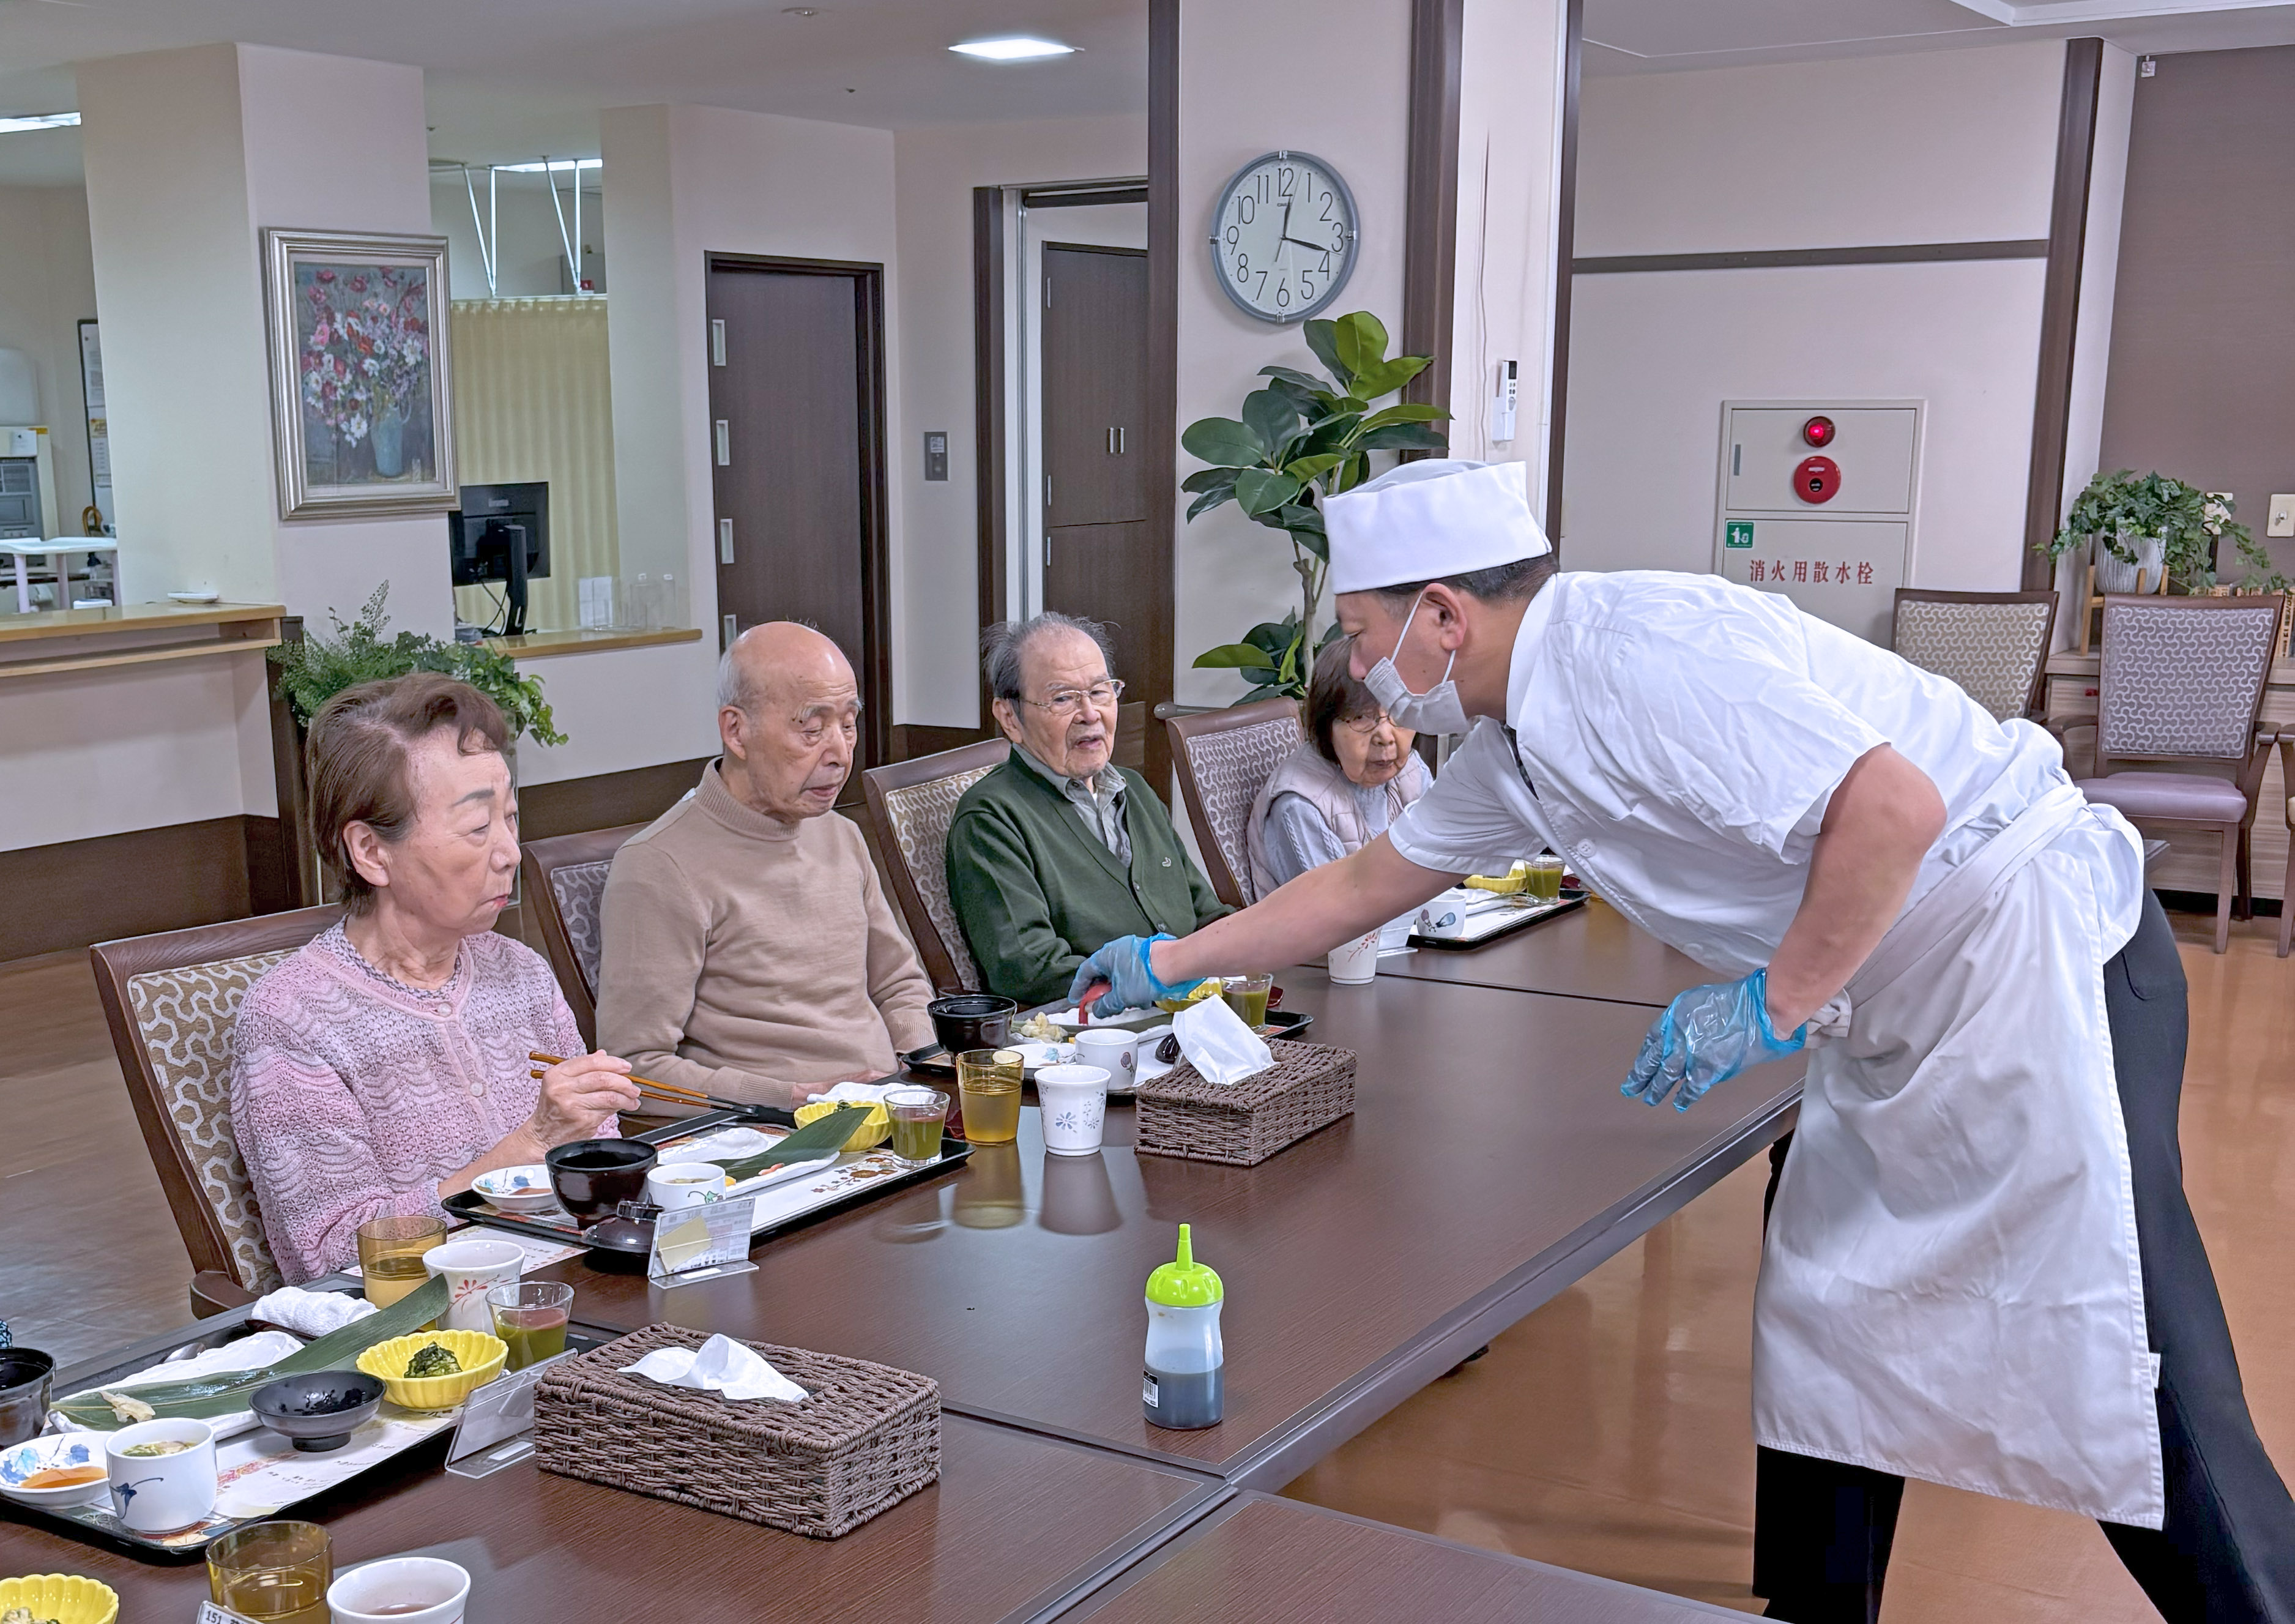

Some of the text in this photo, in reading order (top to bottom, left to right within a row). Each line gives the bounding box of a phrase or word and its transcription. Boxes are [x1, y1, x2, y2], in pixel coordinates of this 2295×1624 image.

[1257, 176, 1268, 204] 11
[1278, 168, 1294, 197] 12
[1307, 173, 1311, 203] 1
[1237, 196, 1255, 225] 10
[1319, 192, 1333, 221] 2
[1227, 225, 1240, 256] 9
[1331, 222, 1344, 253] 3
[1237, 253, 1249, 283] 8
[1318, 250, 1330, 280] 4
[1255, 271, 1268, 300] 7
[1276, 277, 1290, 307] 6
[1301, 270, 1315, 300] 5
[1749, 559, 1873, 584] 消火用散水栓
